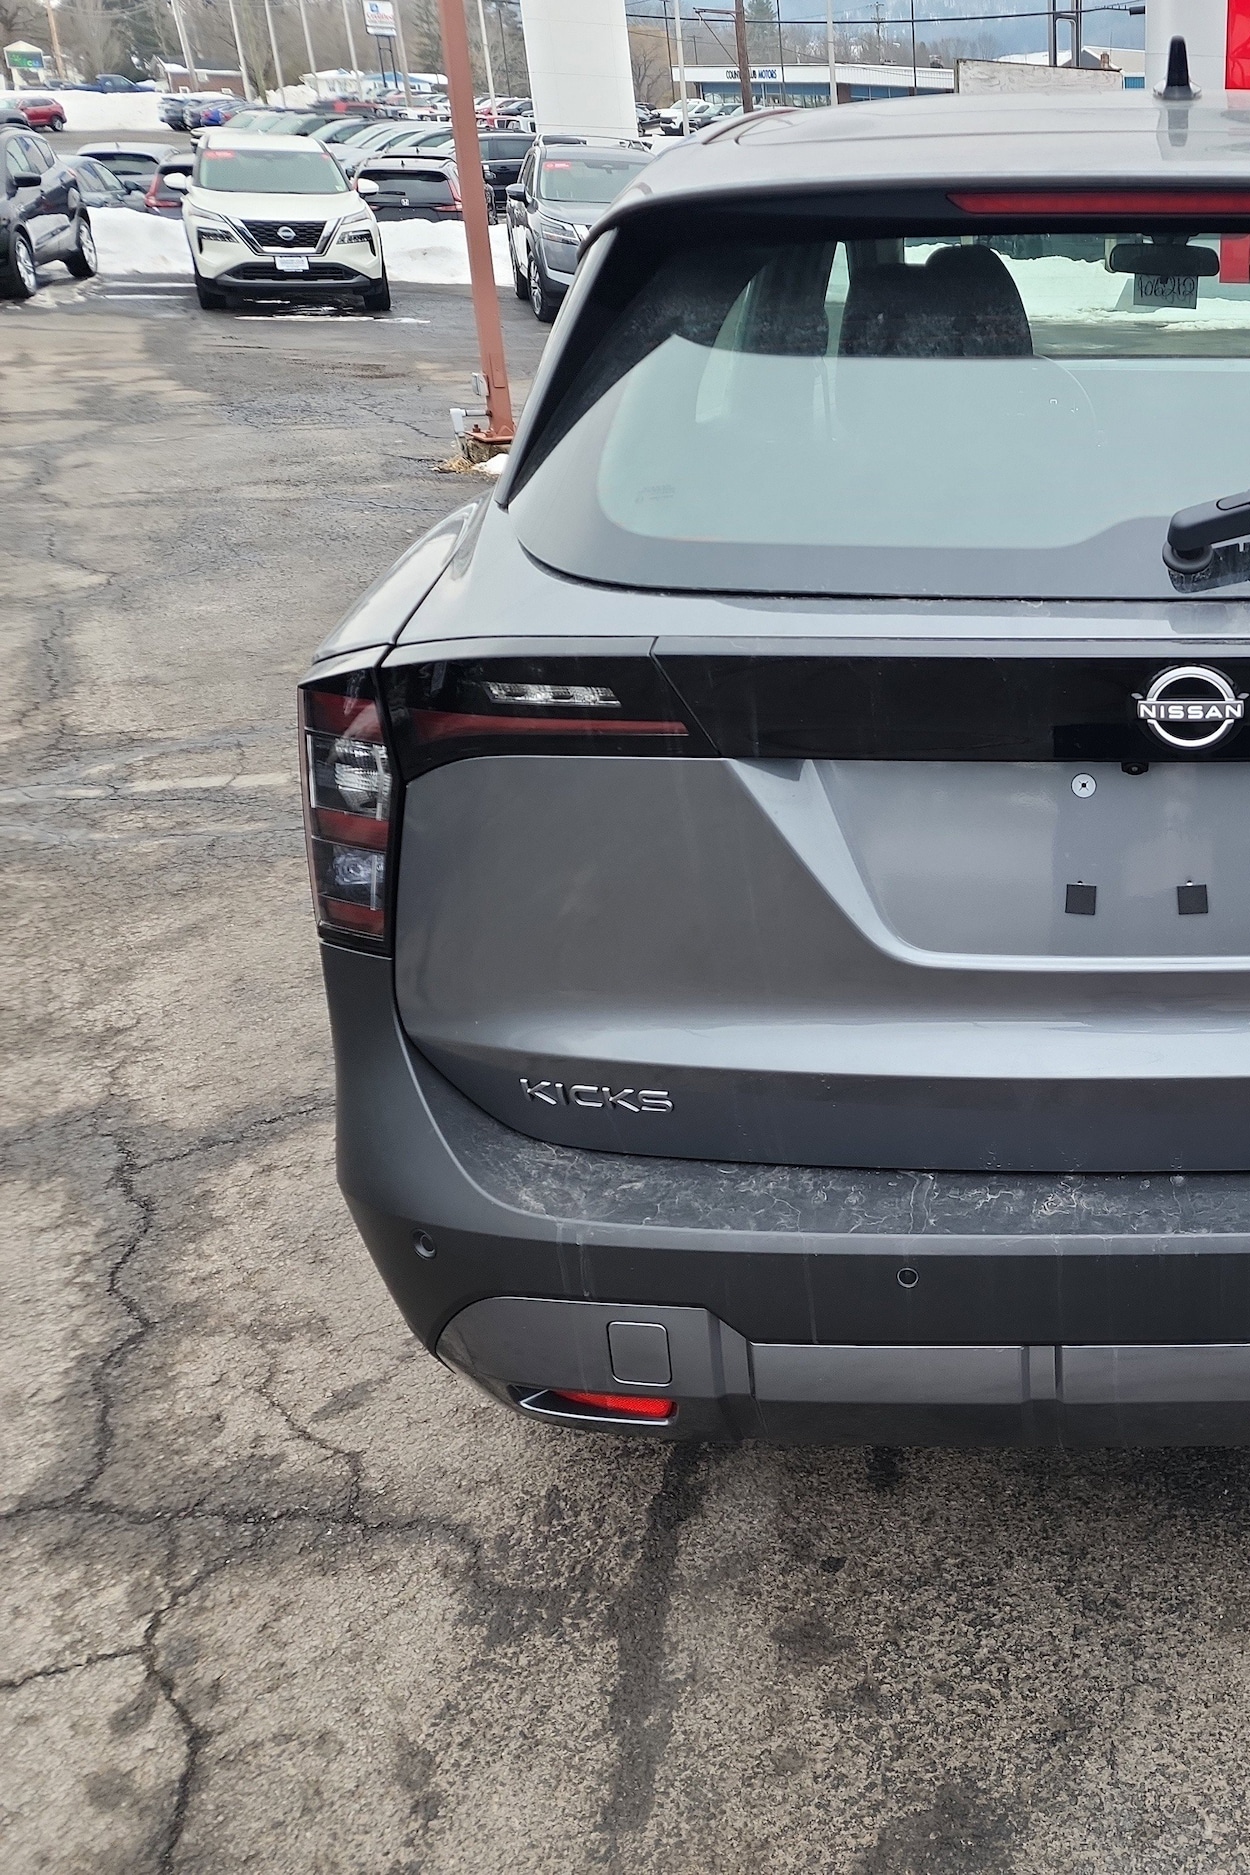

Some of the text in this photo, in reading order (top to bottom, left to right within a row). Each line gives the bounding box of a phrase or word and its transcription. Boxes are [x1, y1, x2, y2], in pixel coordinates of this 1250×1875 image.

[758, 69, 777, 79] MOTORS
[1139, 703, 1242, 719] NISSAN
[519, 1078, 674, 1113] KICKS
